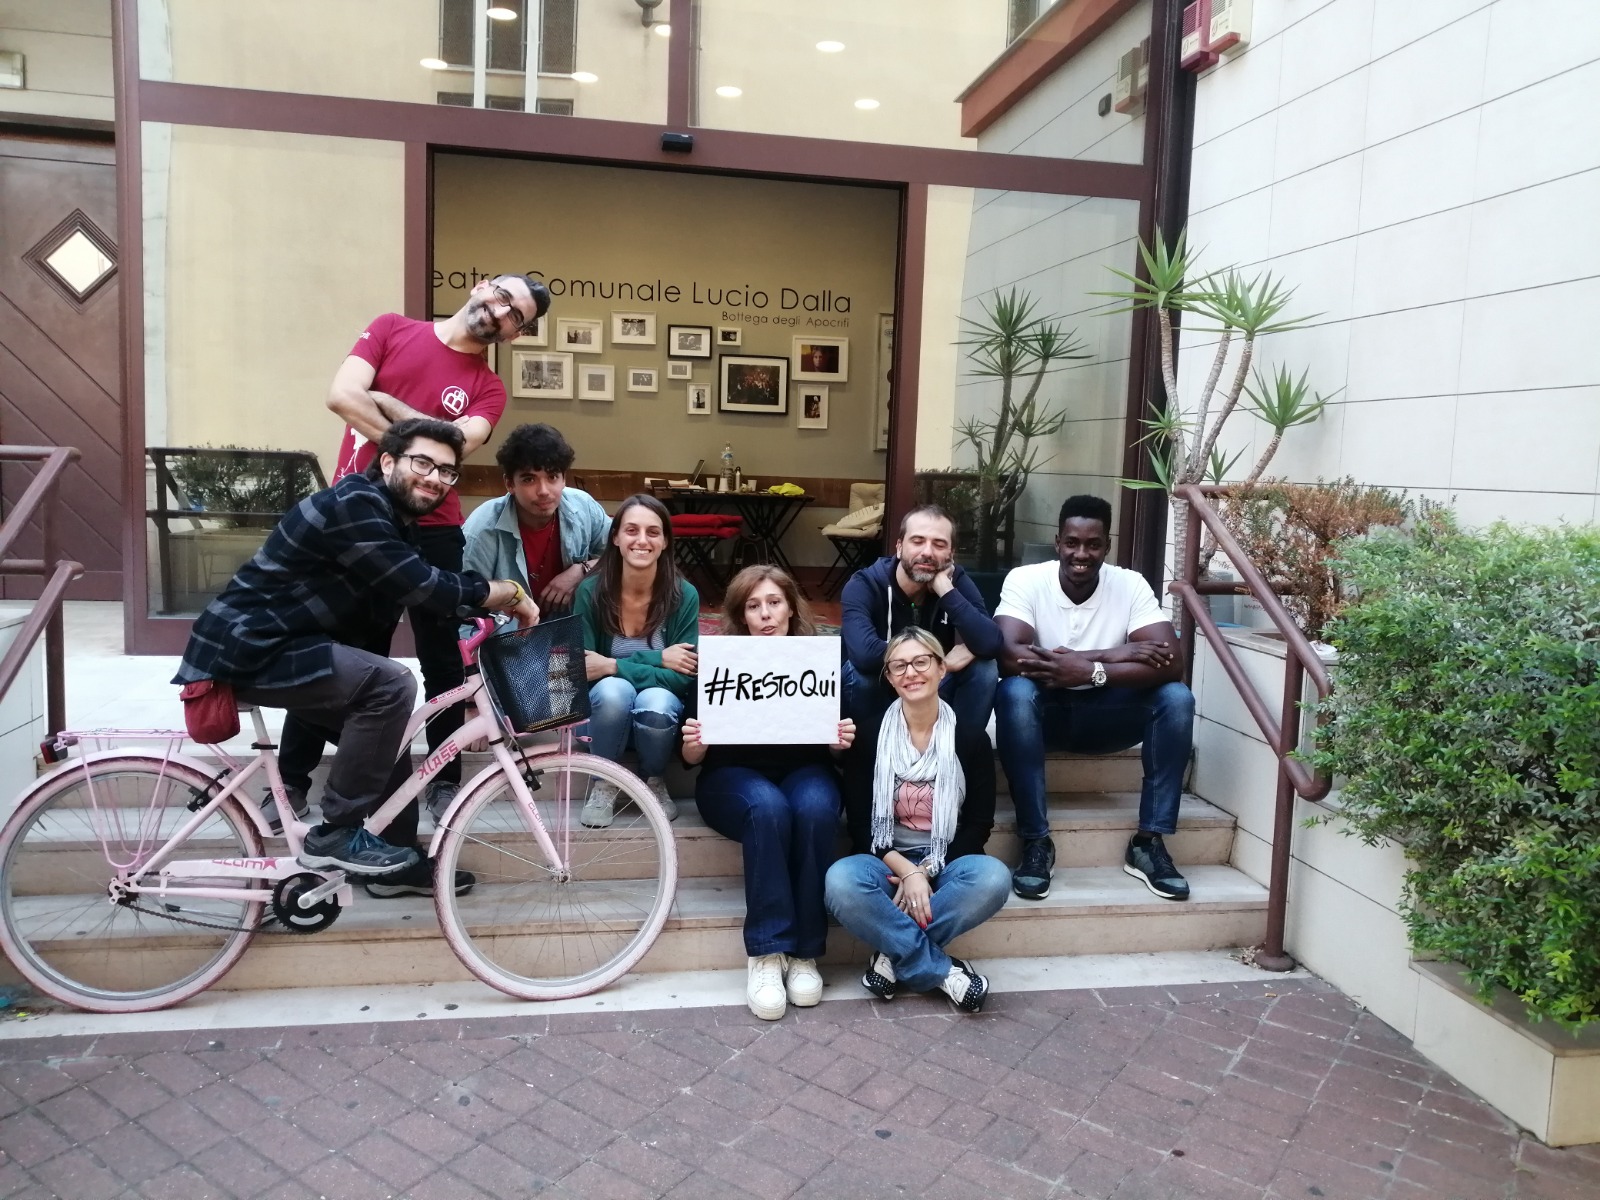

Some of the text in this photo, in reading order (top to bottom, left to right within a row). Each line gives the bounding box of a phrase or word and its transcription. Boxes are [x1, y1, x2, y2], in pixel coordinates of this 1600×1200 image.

[433, 267, 501, 289] eatr
[693, 281, 769, 308] Lucio
[781, 288, 850, 313] Dalla
[722, 311, 849, 328] Bottega degli Apocrifi
